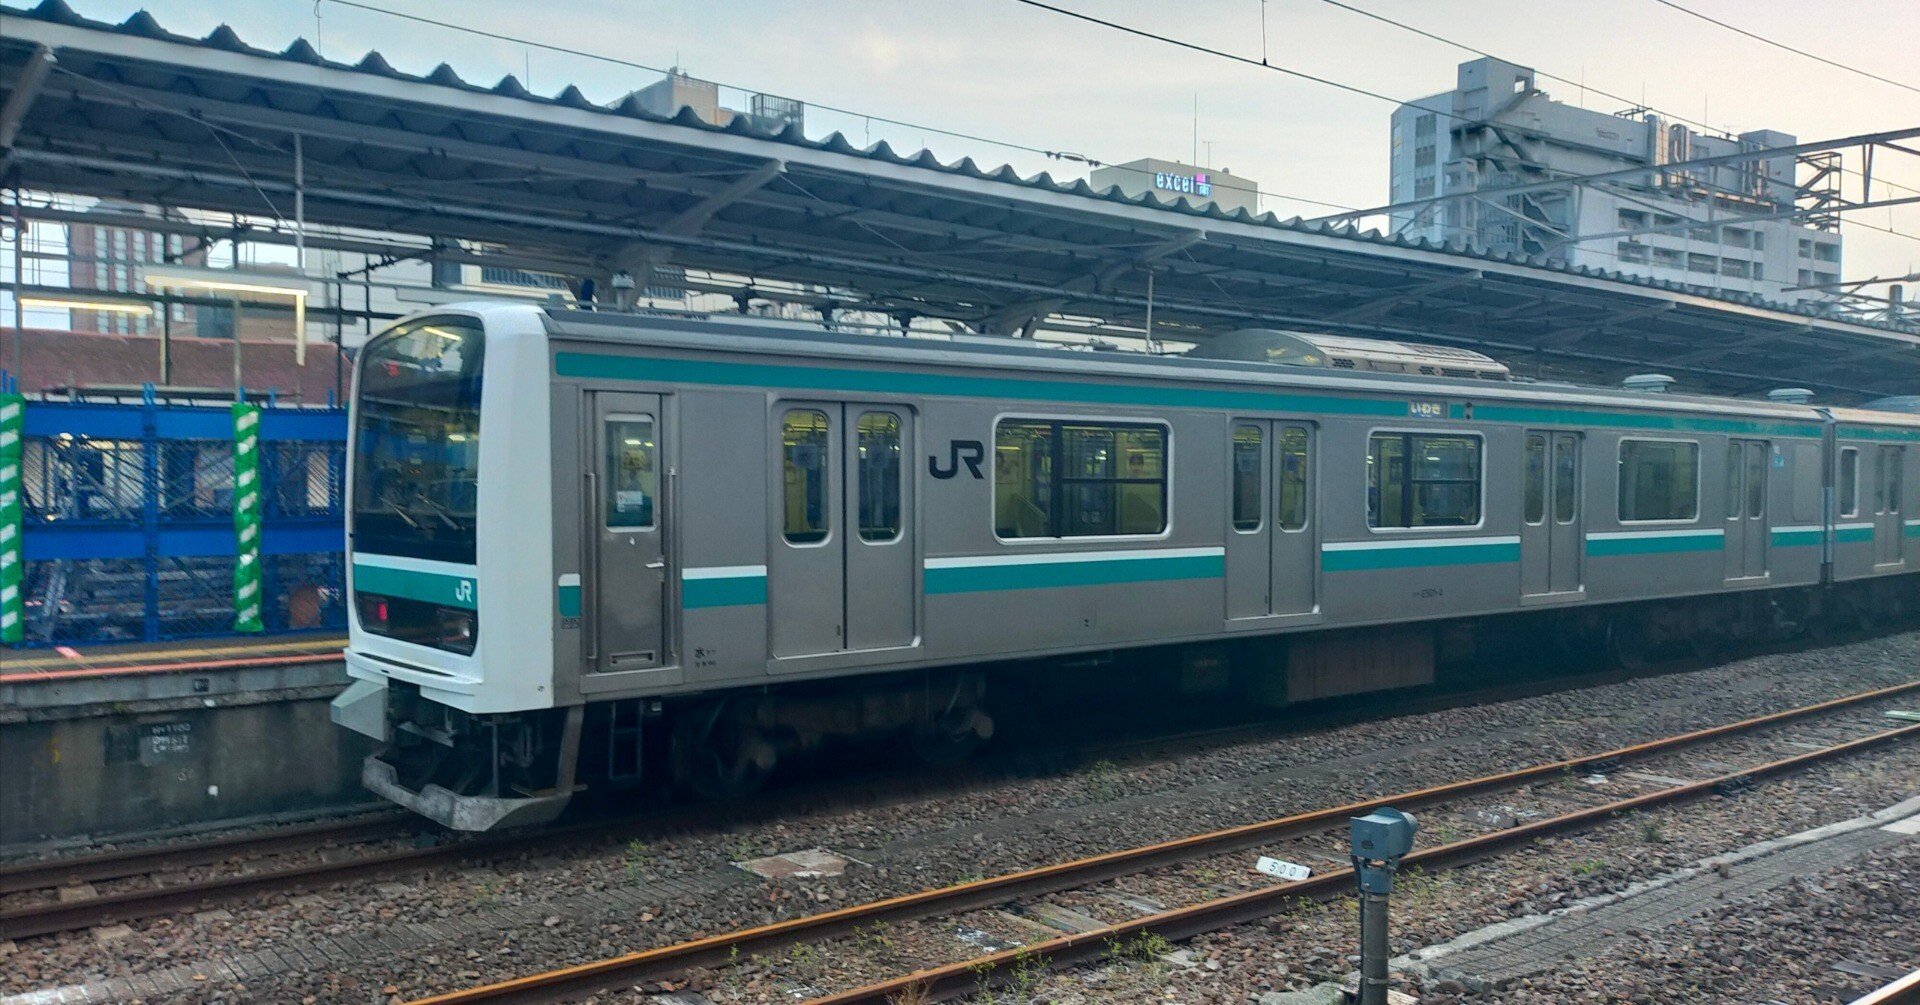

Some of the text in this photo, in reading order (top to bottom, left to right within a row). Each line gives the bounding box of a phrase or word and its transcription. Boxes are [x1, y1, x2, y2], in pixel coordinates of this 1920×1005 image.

[1156, 172, 1194, 194] excel
[1410, 402, 1440, 415] いわき
[928, 439, 985, 480] JR
[454, 579, 473, 604] JR
